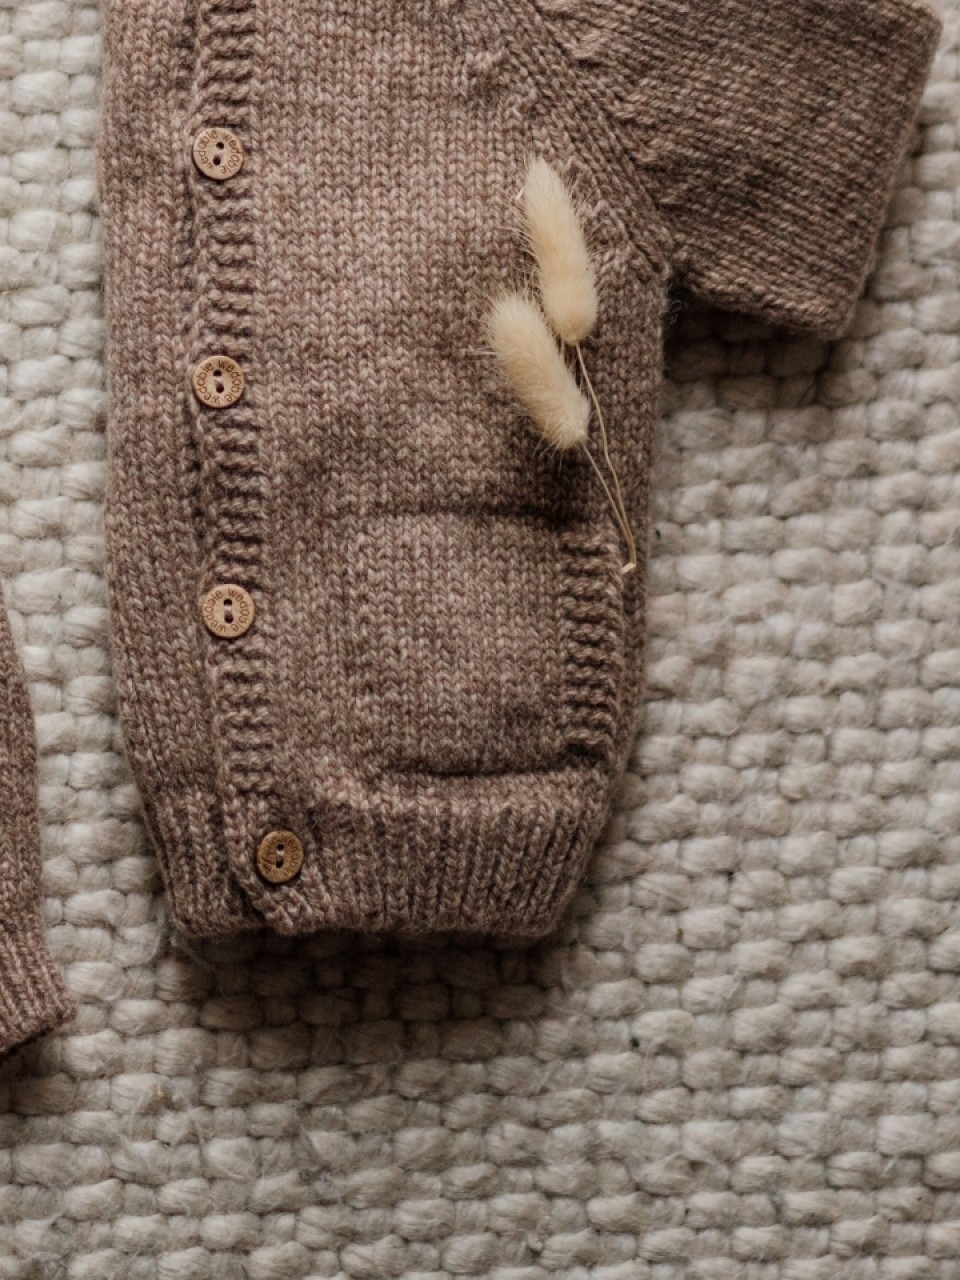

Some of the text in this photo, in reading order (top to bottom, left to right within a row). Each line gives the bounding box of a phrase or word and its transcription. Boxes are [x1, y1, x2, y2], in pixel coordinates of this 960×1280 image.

[220, 132, 243, 174] wedoble
[196, 363, 220, 404] wedoble
[219, 360, 244, 402] wedoble
[203, 590, 225, 632] wedoble
[228, 589, 253, 632] wedoble
